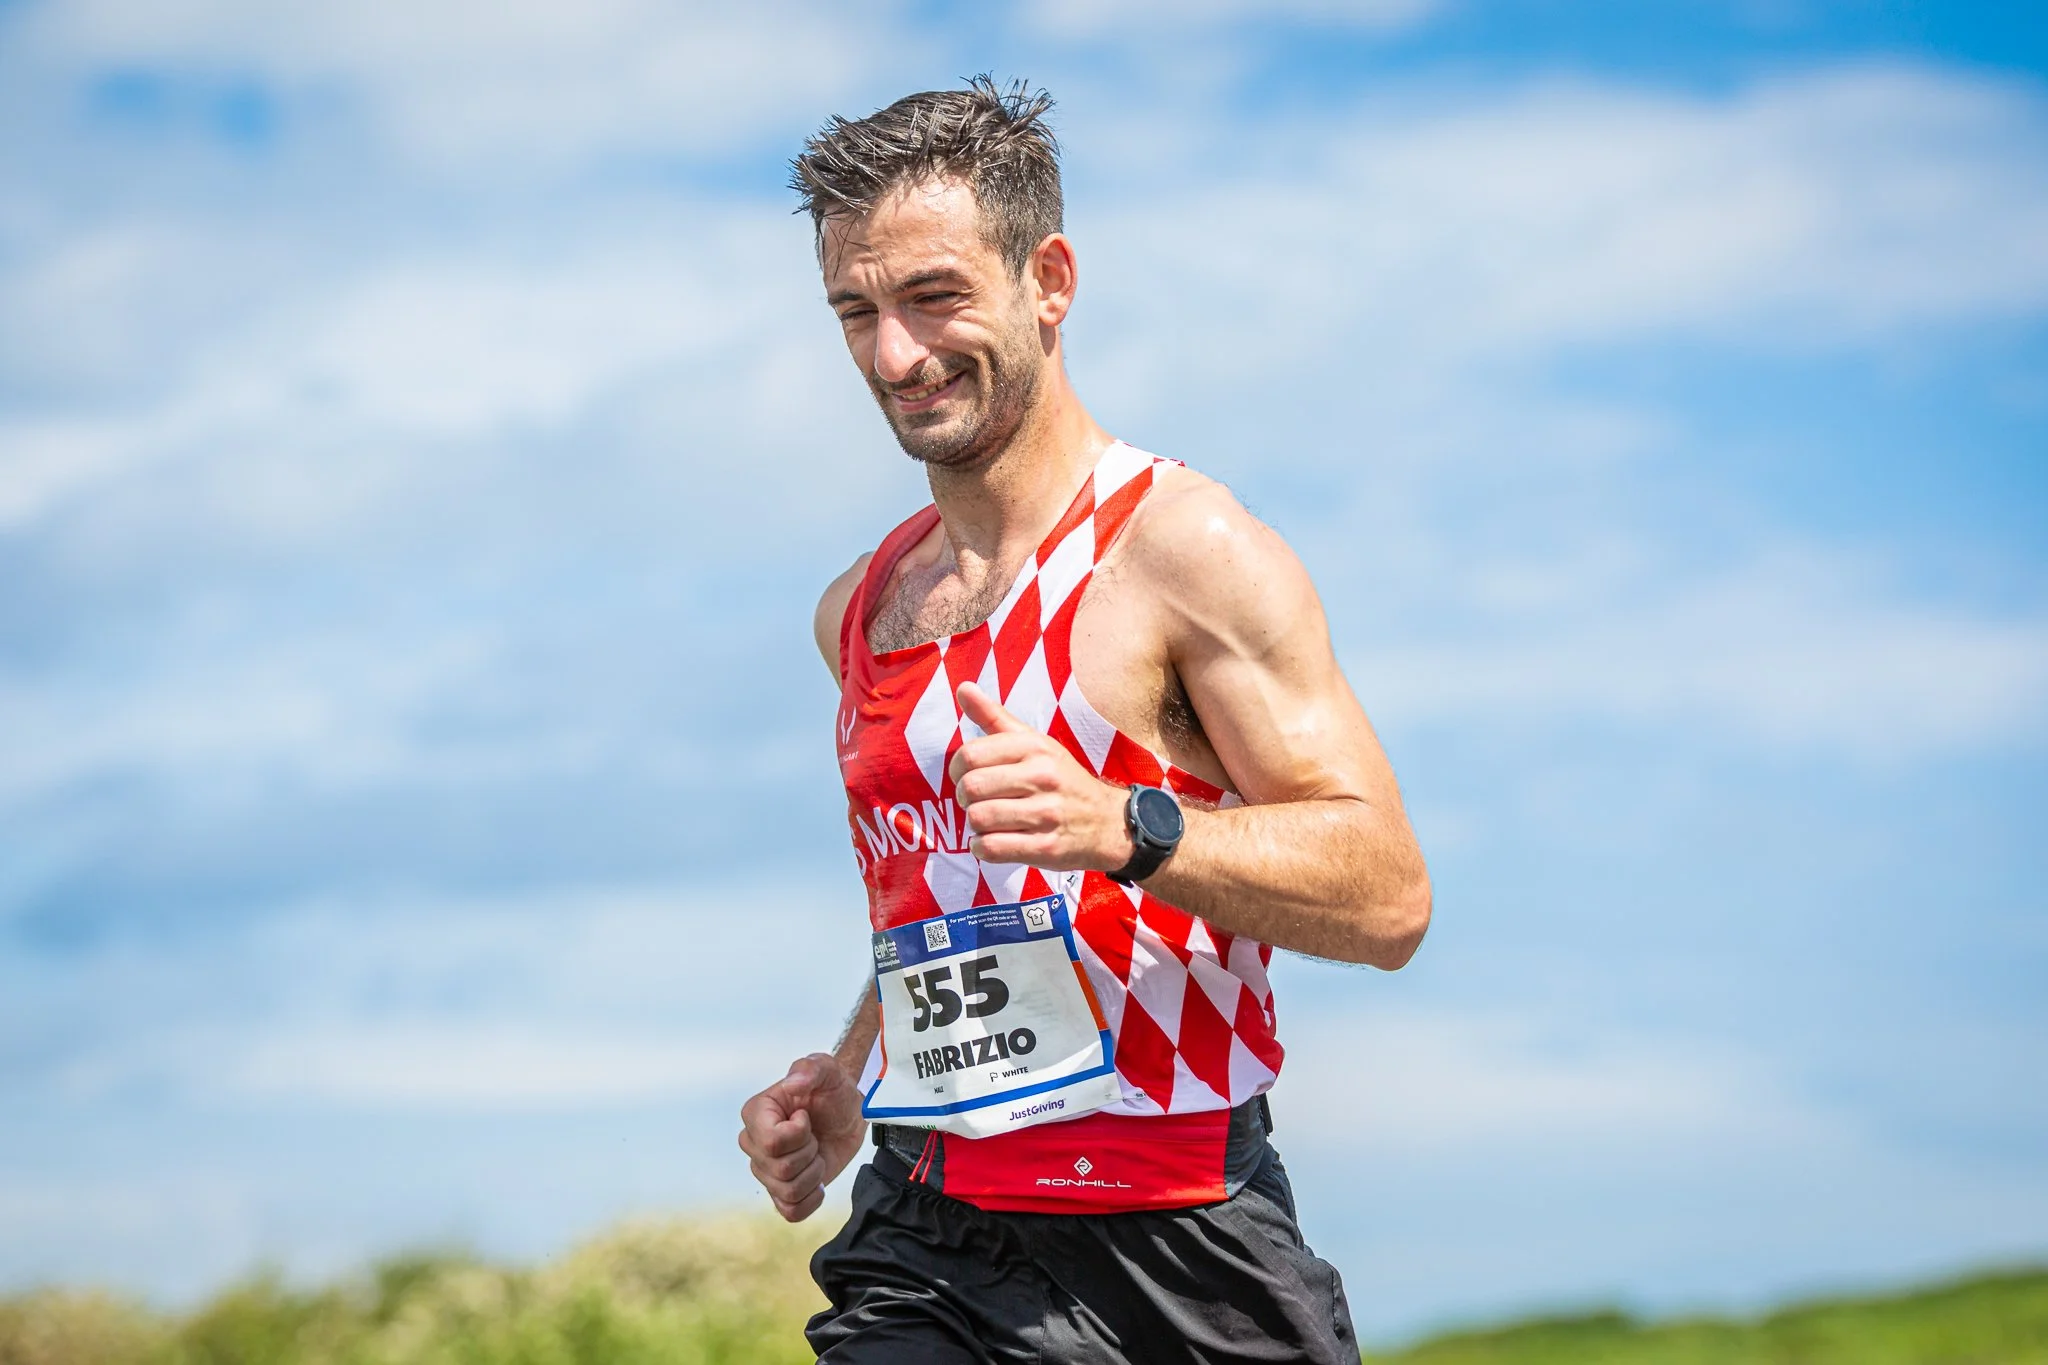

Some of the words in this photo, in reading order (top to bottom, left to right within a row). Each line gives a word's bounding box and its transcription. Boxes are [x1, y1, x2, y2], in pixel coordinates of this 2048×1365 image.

[903, 954, 1010, 1032] 555
[912, 1027, 1037, 1080] FABRIZIO
[1001, 1066, 1029, 1078] WHITE
[1009, 1099, 1065, 1121] JustGiving
[1035, 1178, 1132, 1188] RONHILL
